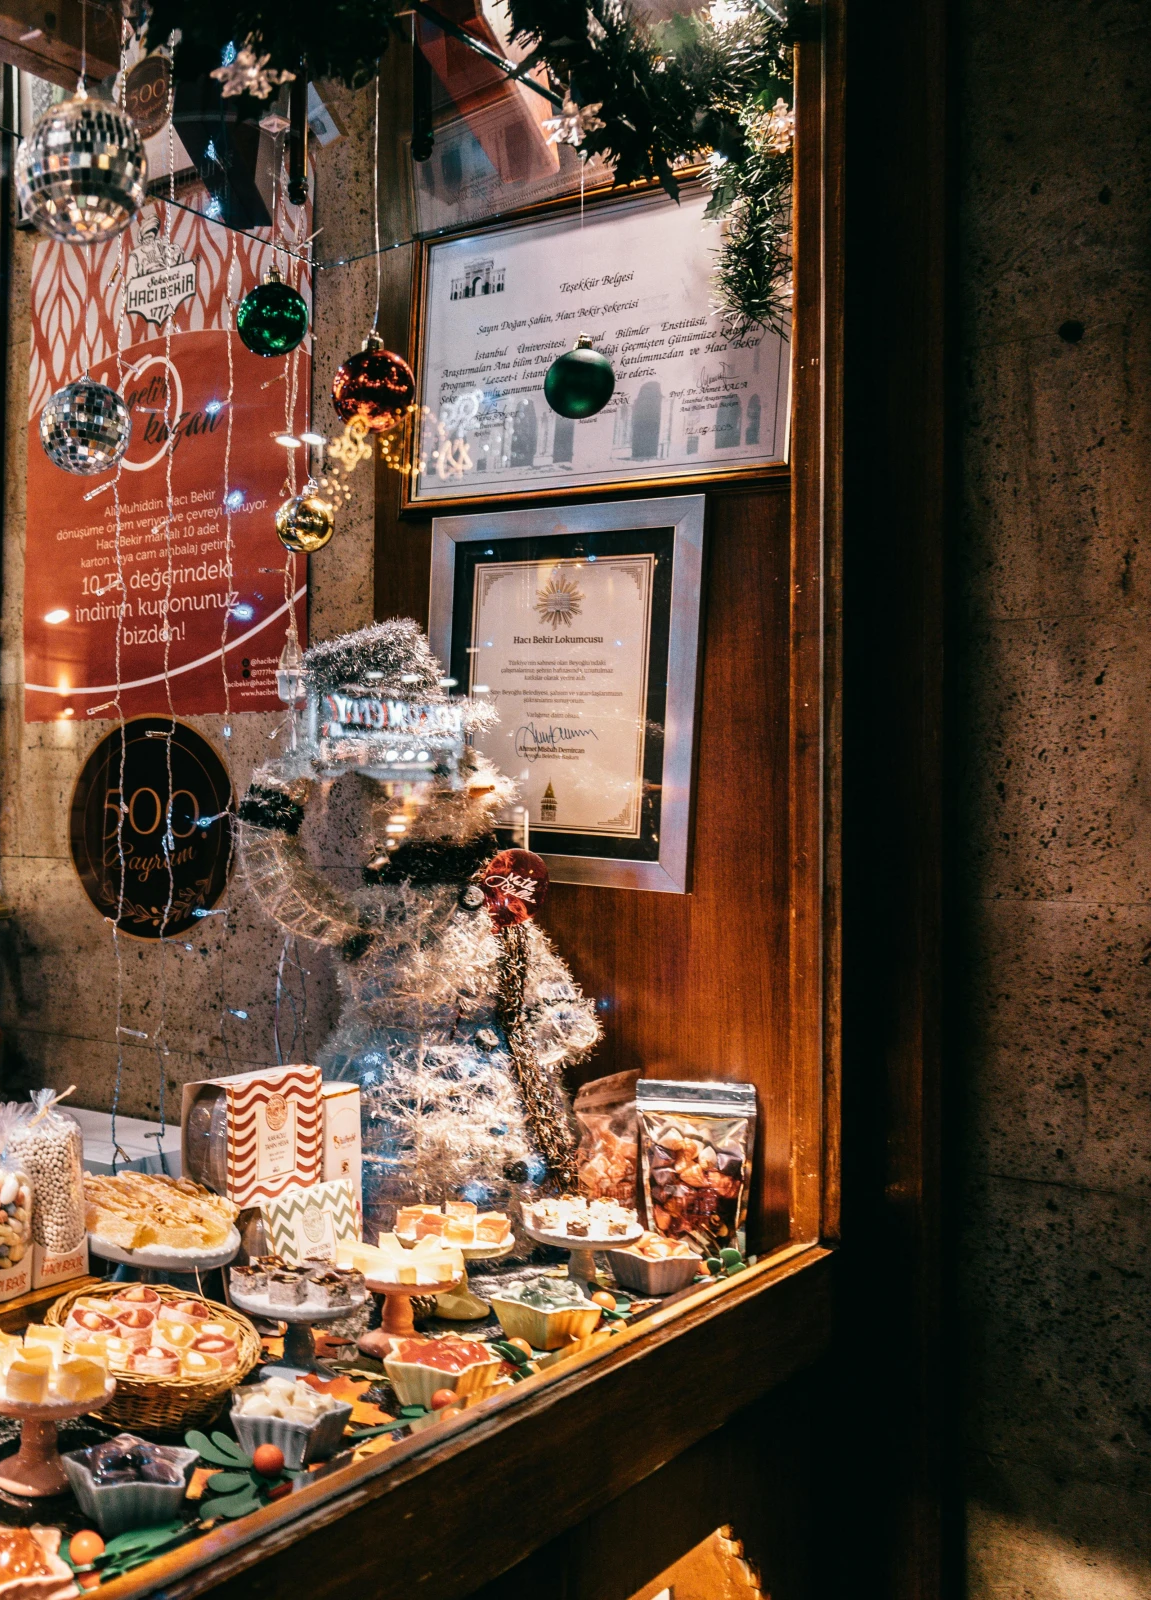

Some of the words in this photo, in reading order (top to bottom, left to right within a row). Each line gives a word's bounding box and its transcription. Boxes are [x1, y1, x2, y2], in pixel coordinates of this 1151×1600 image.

[129, 288, 158, 309] HACI
[160, 273, 194, 300] BEKİR
[559, 275, 599, 294] Teşekkür
[601, 270, 635, 287] Belgesi
[150, 304, 169, 320] 1777
[476, 324, 499, 337] Sayın
[500, 317, 527, 331] Doğan
[527, 314, 553, 329] Şahin,
[555, 311, 576, 323] Hacı
[577, 306, 601, 320] Bekir
[600, 299, 640, 316] Şekercisi
[474, 346, 509, 361] İstanbul
[517, 338, 567, 355] Üniversitesi,
[615, 325, 650, 340] Bilimler
[660, 316, 708, 332] Enstitüsü,
[440, 380, 477, 392] Programı,
[620, 349, 684, 367] katılımınızdan
[689, 347, 700, 356] ve
[704, 341, 728, 354] Hacı
[732, 336, 760, 350] Bekir
[441, 363, 492, 379] Araştırmaları
[493, 361, 511, 371] Ana
[512, 356, 533, 368] bilim
[621, 338, 665, 354] Geçmişten
[667, 330, 717, 347] Günümüze
[628, 366, 657, 379] ederiz.
[119, 498, 164, 515] Muhiddin
[190, 489, 216, 503] Bekir
[56, 525, 105, 541] dönüşüme
[186, 503, 223, 523] çevreyi
[119, 534, 142, 547] Bekir
[183, 525, 195, 538] 10
[197, 522, 220, 537] adet
[80, 556, 109, 569] karton
[135, 548, 156, 560] cam
[81, 575, 100, 595] 10
[129, 558, 234, 591] değerindeki
[75, 601, 133, 622] indirim
[138, 591, 240, 619] kuponunuz
[122, 621, 186, 645] bizden!
[513, 636, 532, 644] Hacı
[532, 635, 554, 644] Bekir
[555, 635, 604, 644] Lokumcusu
[103, 841, 196, 883] Bayram
[41, 1260, 61, 1276] HACI
